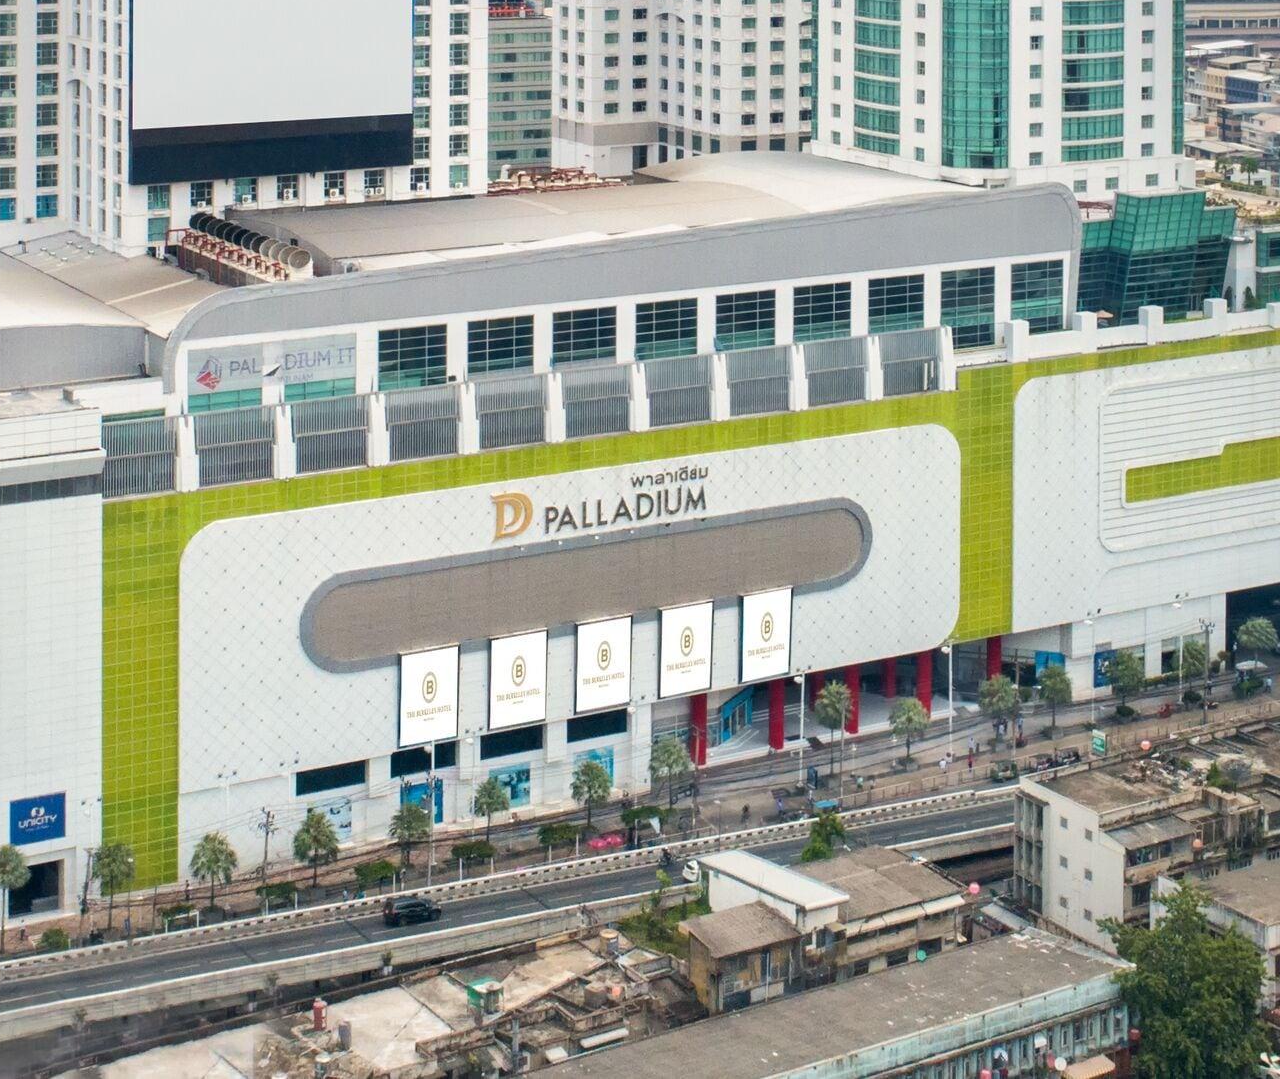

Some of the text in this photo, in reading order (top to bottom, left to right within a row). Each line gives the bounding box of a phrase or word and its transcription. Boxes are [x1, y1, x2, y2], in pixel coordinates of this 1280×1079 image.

[230, 347, 355, 377] PALDIUM IT
[631, 465, 709, 488] พาลาเดียม
[544, 485, 707, 534] PALLADIUM
[764, 620, 770, 634] B
[684, 634, 691, 648] B
[600, 648, 608, 663] B
[515, 664, 523, 678] B
[426, 680, 434, 694] B
